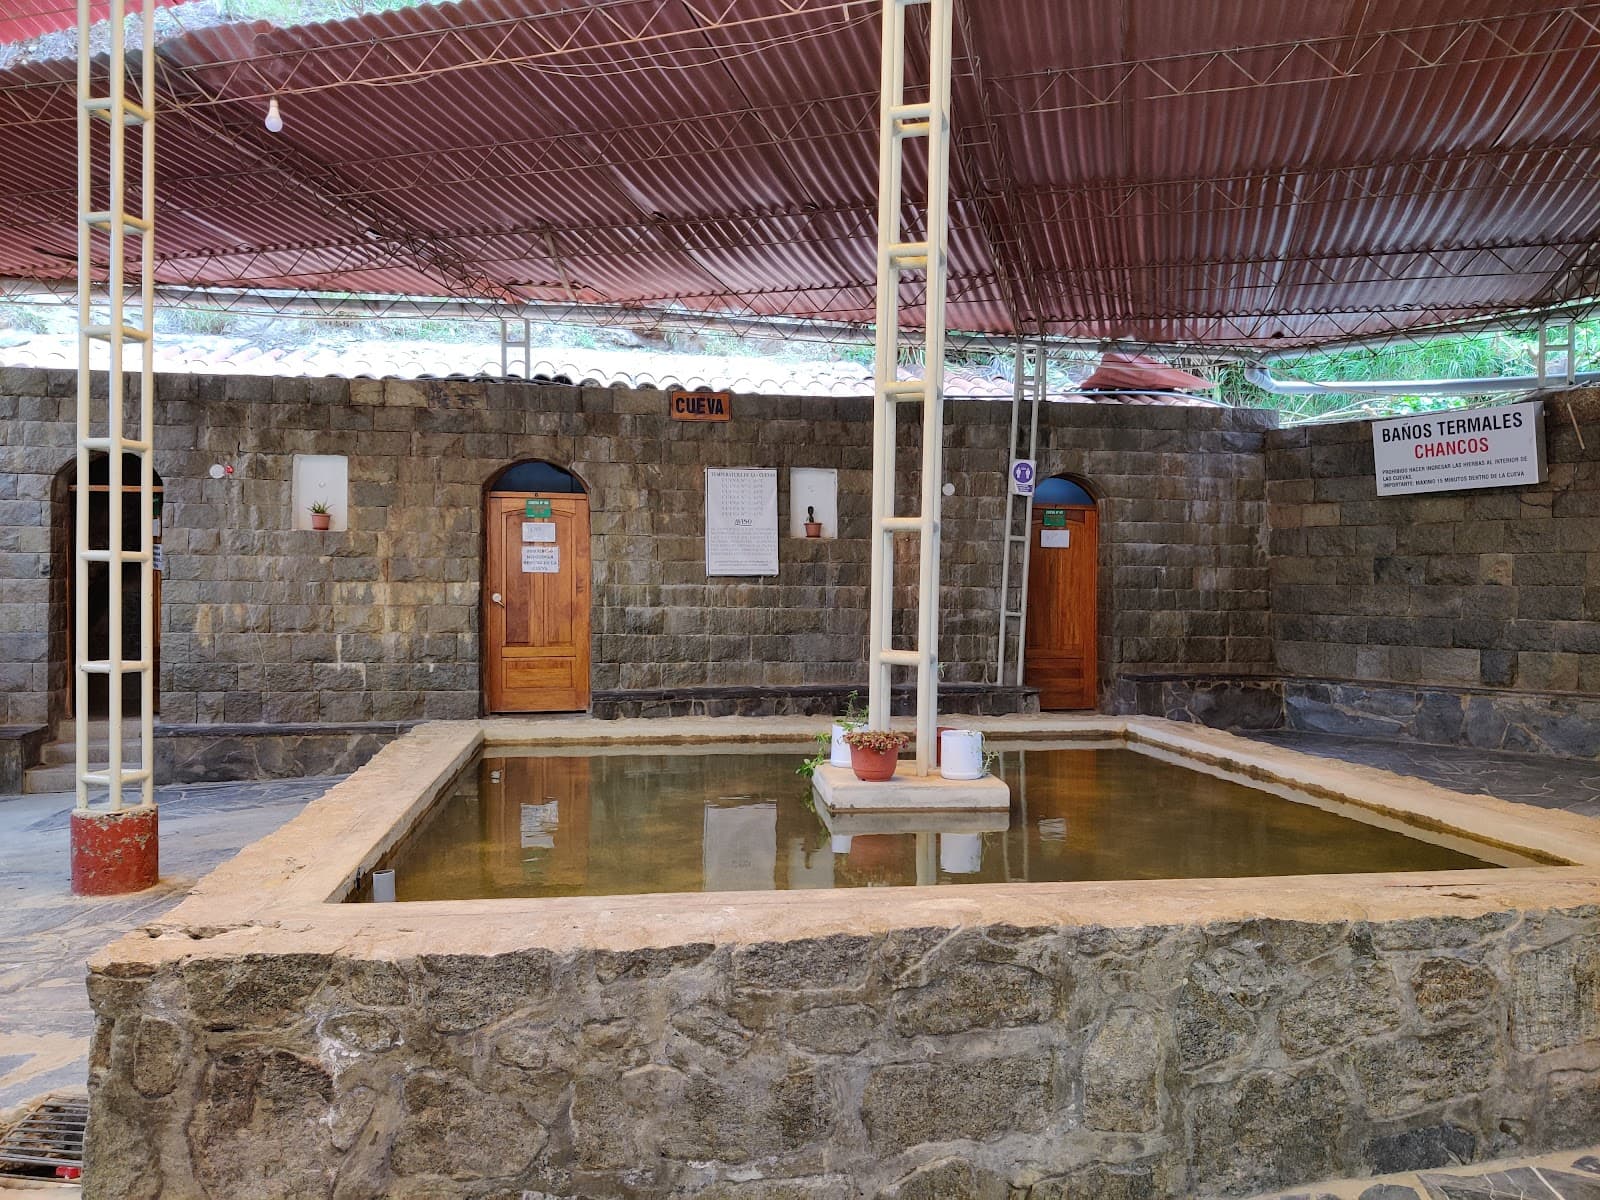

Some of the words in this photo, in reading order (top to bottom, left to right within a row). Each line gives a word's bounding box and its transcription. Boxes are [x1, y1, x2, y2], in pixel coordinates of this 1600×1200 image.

[676, 397, 724, 415] CUEVA
[1382, 422, 1432, 443] BAÑOS
[1437, 412, 1523, 436] TERMALES
[1414, 437, 1489, 459] CHANCOS
[1409, 465, 1425, 473] HACER
[1426, 463, 1451, 471] INGRESAR
[1463, 460, 1485, 468] HIERBAS
[1494, 456, 1519, 465] INTERIOR
[1415, 478, 1436, 486] MAXIMO
[1444, 475, 1468, 483] MINUTOS
[1468, 473, 1489, 481] DENTRO
